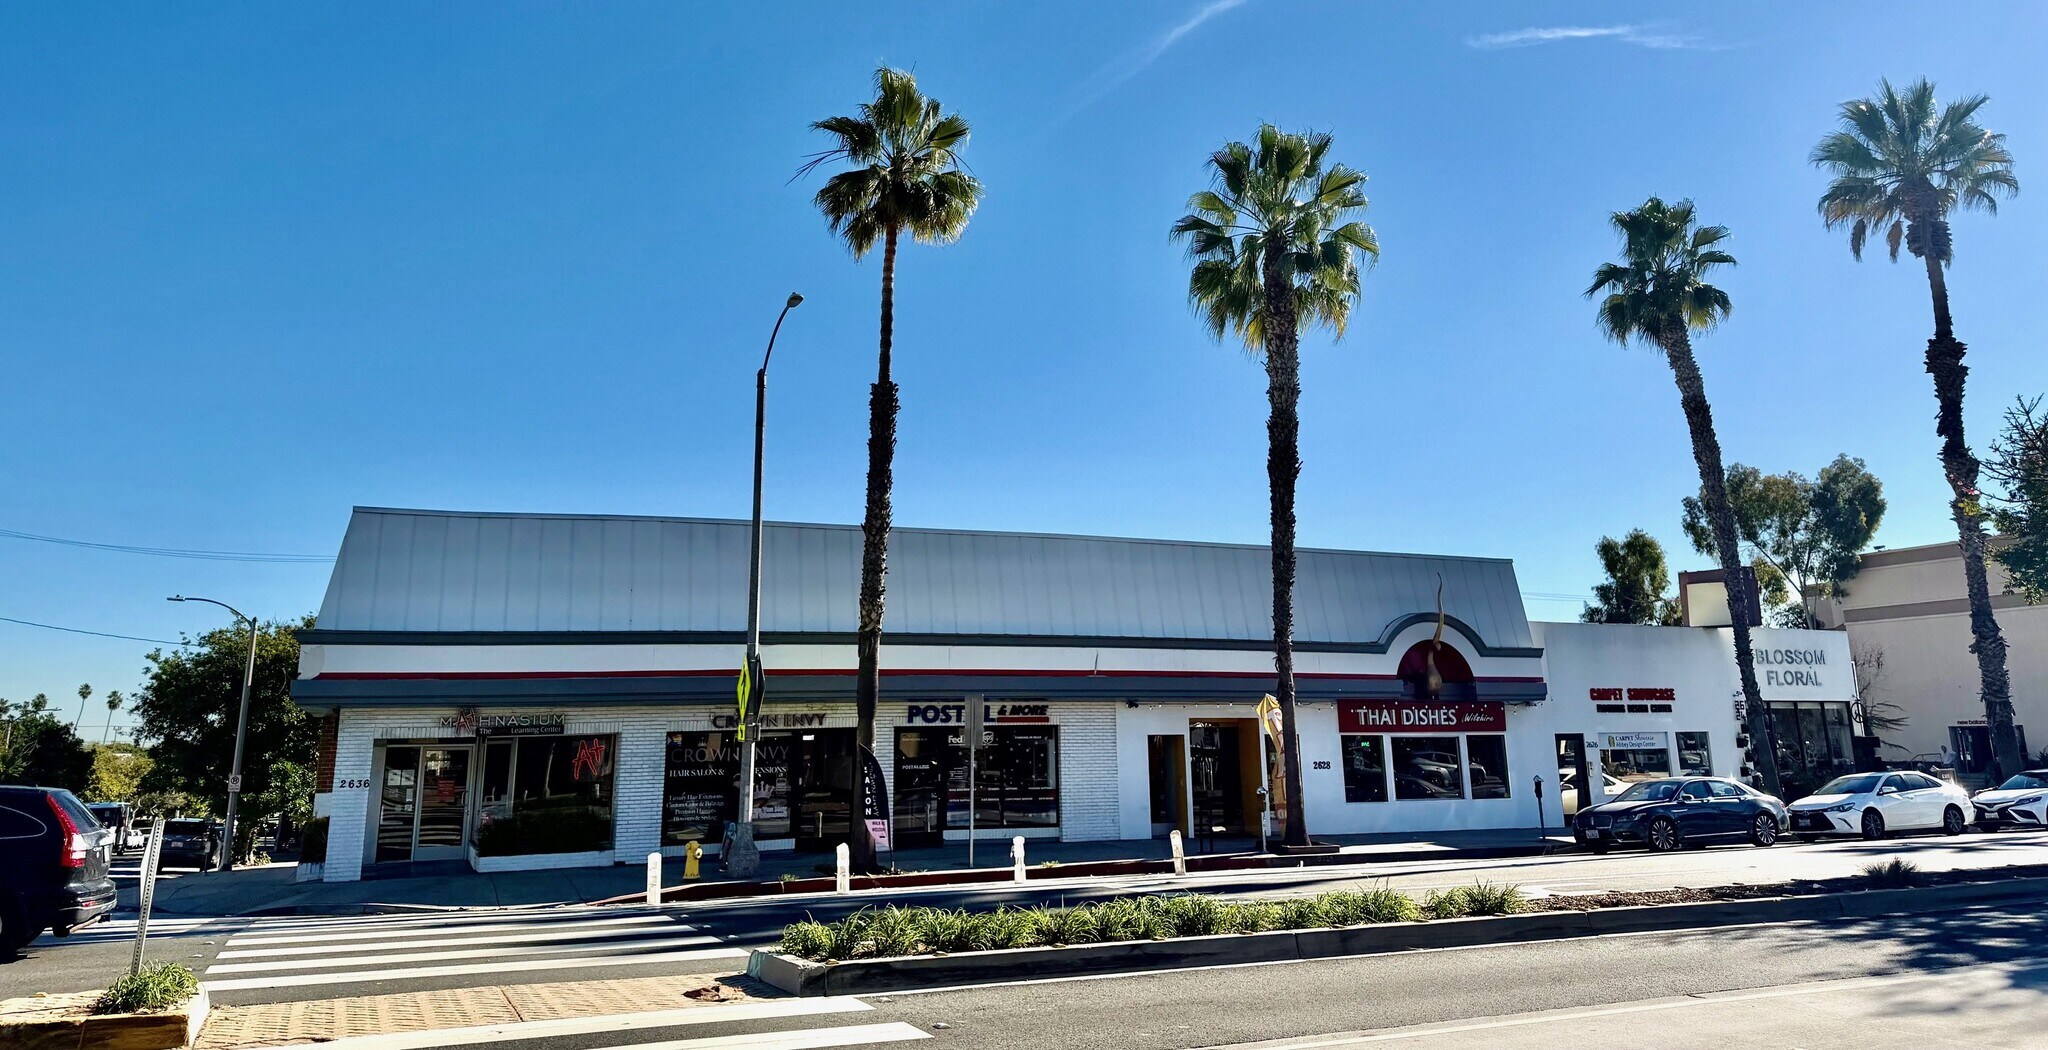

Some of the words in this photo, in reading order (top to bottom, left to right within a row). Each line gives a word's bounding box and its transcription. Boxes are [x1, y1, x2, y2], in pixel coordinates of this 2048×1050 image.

[1755, 649, 1825, 665] BLOSSOM
[1766, 670, 1823, 686] FLORAL
[712, 714, 778, 728] CRN
[784, 713, 826, 727] ENVY
[908, 705, 996, 723] POSTL
[998, 705, 1007, 715] &
[1009, 705, 1049, 715] MORE
[1356, 709, 1397, 725] THAI
[1401, 709, 1457, 725] DISHES
[948, 735, 966, 744] Fed
[755, 746, 790, 760] NVY
[669, 769, 690, 778] HAIR
[690, 769, 717, 777] SALON
[755, 766, 787, 775] ENSIONS
[1313, 761, 1331, 769] 2628
[339, 779, 370, 789] 2636
